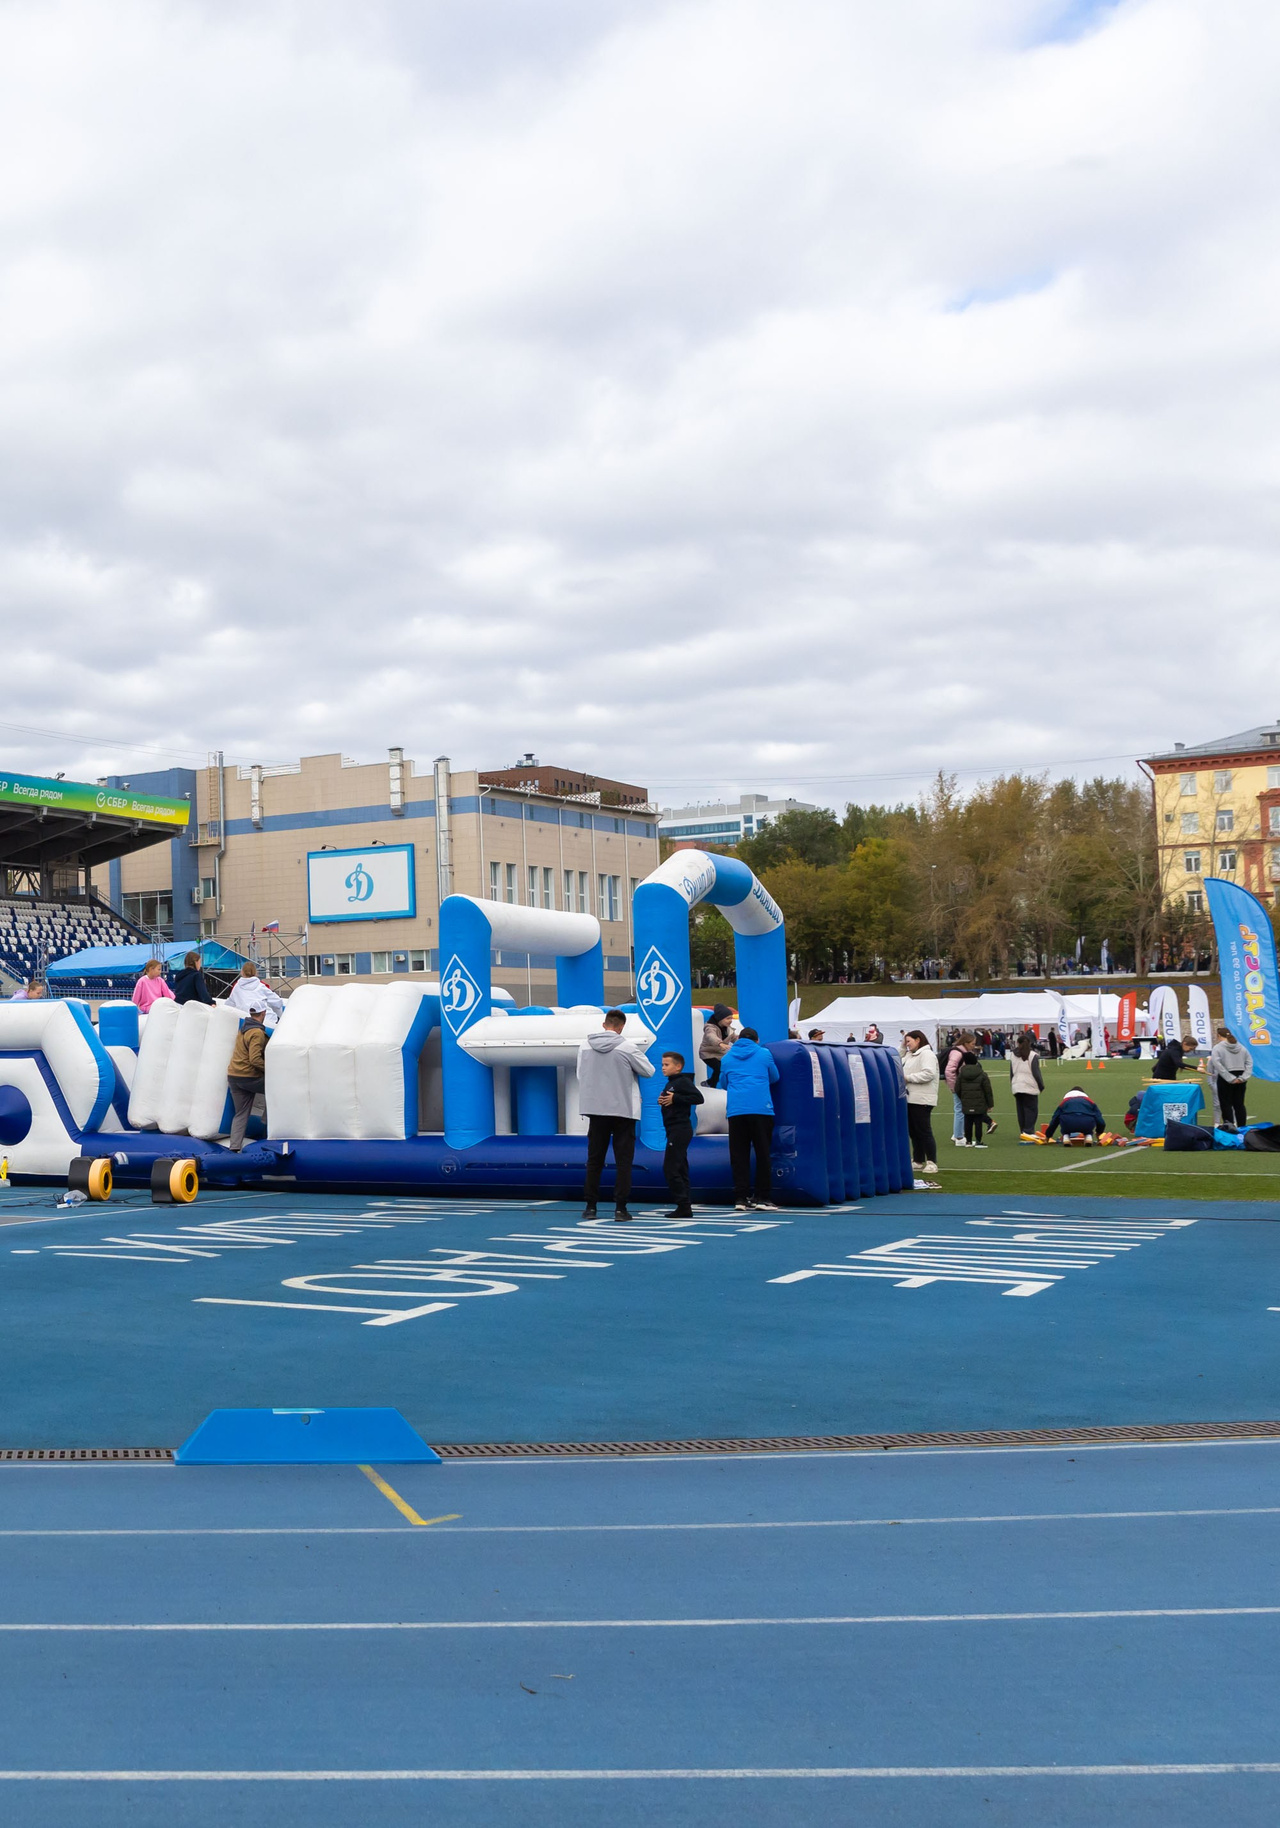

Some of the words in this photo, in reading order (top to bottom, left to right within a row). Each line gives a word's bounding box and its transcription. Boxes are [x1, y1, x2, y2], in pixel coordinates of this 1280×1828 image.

[13, 783, 39, 798] Всегда
[39, 789, 63, 800] рядом
[106, 796, 128, 808] СБЕР
[131, 800, 154, 814] Всегда
[154, 806, 176, 816] рядом
[10, 1199, 562, 1263] ЛУЧШИХ!
[766, 1211, 1199, 1297] ЛУЧШИЕ
